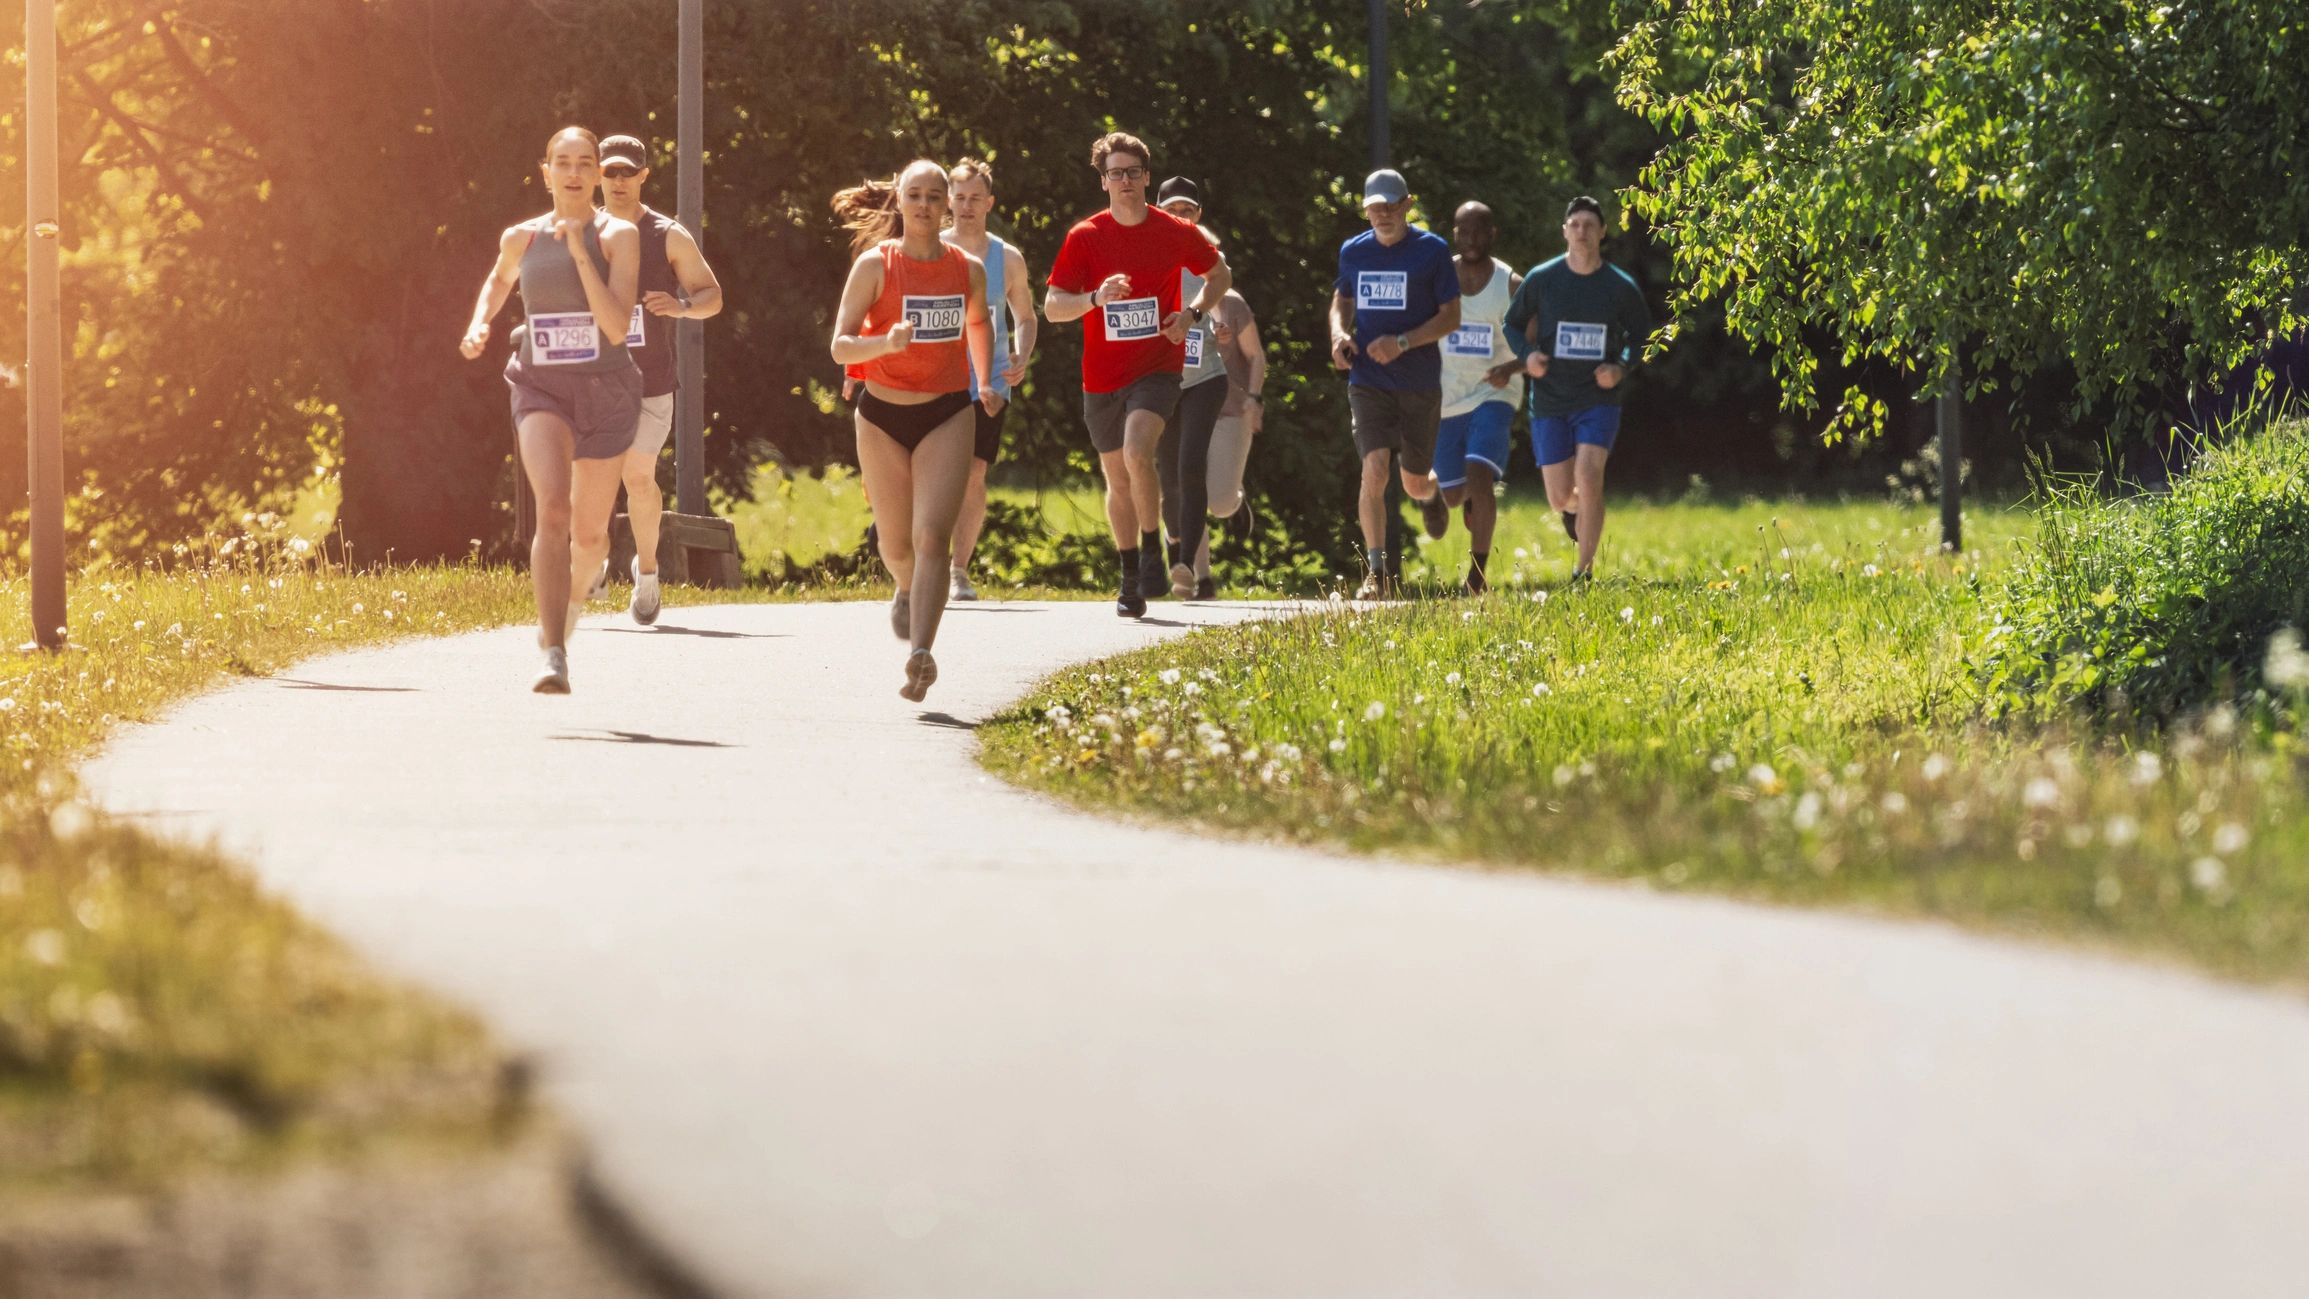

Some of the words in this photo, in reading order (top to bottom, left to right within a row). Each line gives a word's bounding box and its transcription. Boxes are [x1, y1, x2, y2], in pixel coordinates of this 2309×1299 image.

[1374, 284, 1402, 297] 4778
[910, 314, 918, 325] B
[926, 310, 960, 328] 1080
[1110, 316, 1118, 326] A
[1123, 311, 1155, 328] 3047
[538, 334, 548, 346] A
[554, 328, 592, 347] 1296
[1463, 332, 1488, 346] 5214
